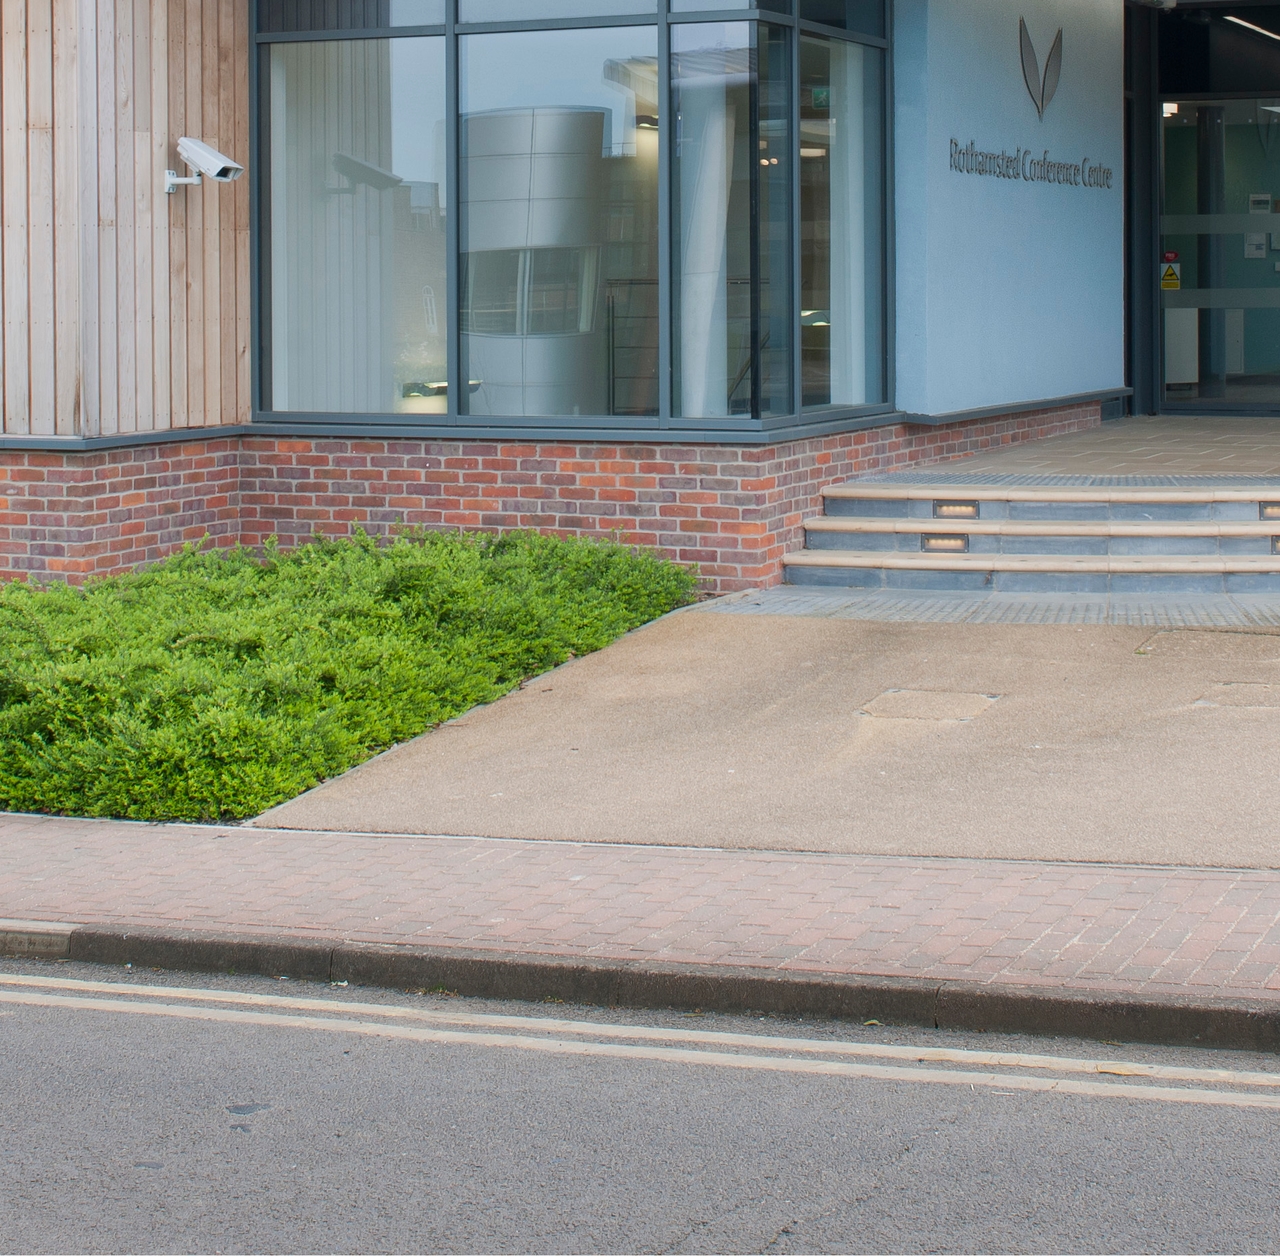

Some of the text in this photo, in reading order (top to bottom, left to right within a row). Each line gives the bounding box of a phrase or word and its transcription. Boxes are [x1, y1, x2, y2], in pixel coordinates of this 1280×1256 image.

[949, 138, 1112, 189] Rothamsted Conference Centre
